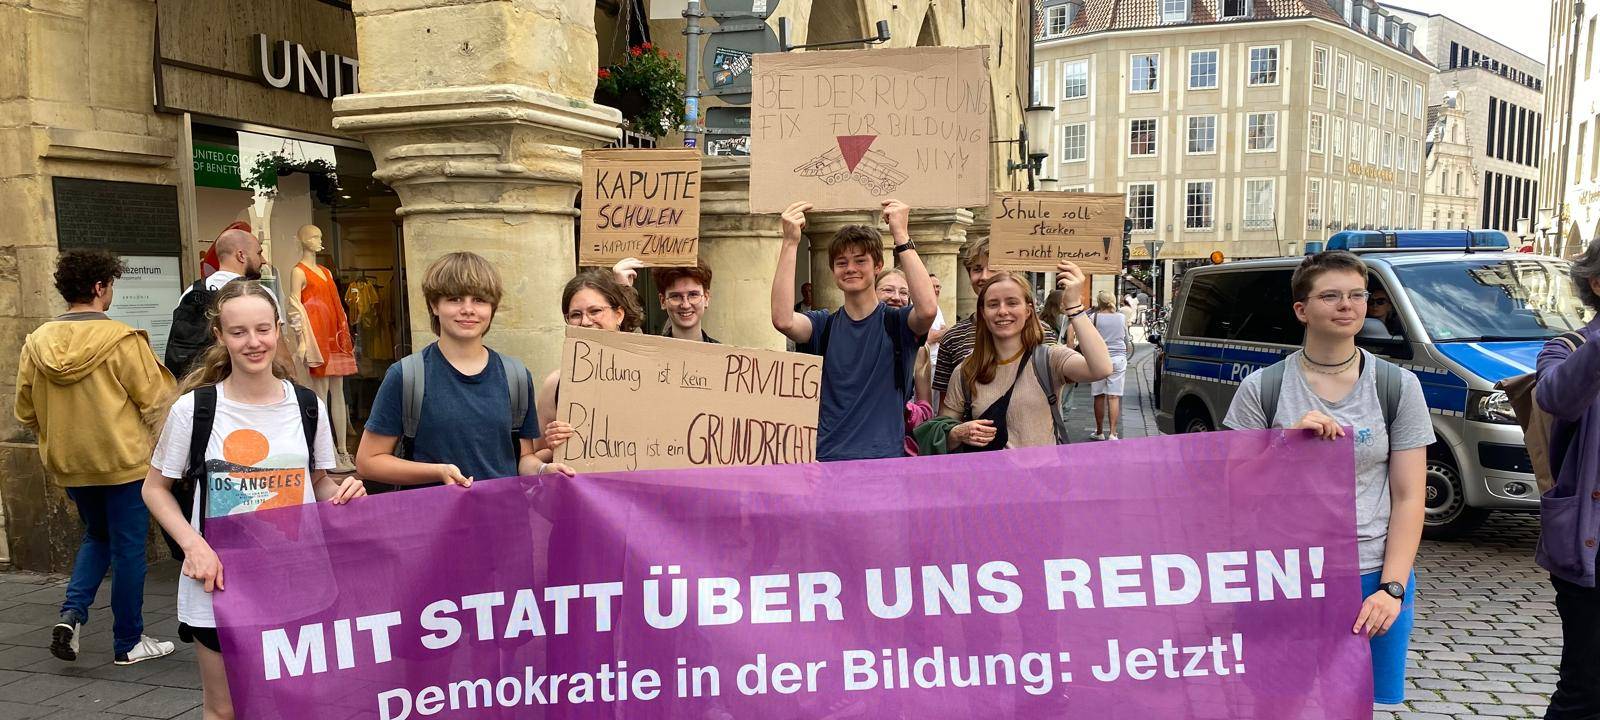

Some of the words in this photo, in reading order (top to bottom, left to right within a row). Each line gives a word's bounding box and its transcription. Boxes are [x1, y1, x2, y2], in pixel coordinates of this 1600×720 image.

[758, 113, 801, 140] FIX
[888, 112, 981, 144] BILDUNG
[596, 168, 698, 200] KAPUTTE
[597, 203, 684, 229] SCHULEN
[996, 197, 1050, 219] Schule
[1062, 206, 1091, 220] soll
[641, 234, 698, 255] ZUKUNFT
[1019, 245, 1052, 258] nicht
[571, 341, 641, 391] Bildung
[657, 363, 671, 384] ist
[680, 361, 709, 388] kein
[564, 402, 637, 471] Bildung
[646, 438, 661, 457] ist
[667, 441, 684, 457] ein
[687, 412, 818, 465] GRUNDRECHT
[210, 477, 232, 490] LOS
[240, 473, 302, 491] ANGELES
[261, 611, 402, 681] MIT
[419, 581, 624, 650] STATT
[643, 564, 845, 630] ÜBER
[865, 560, 1024, 620] UNS
[1043, 546, 1326, 611] REDEN!
[377, 660, 662, 720] Demokratie
[676, 657, 720, 698] in
[736, 653, 827, 696] der
[842, 646, 1073, 695] Bildung:
[1091, 633, 1247, 683] Jetzt!
